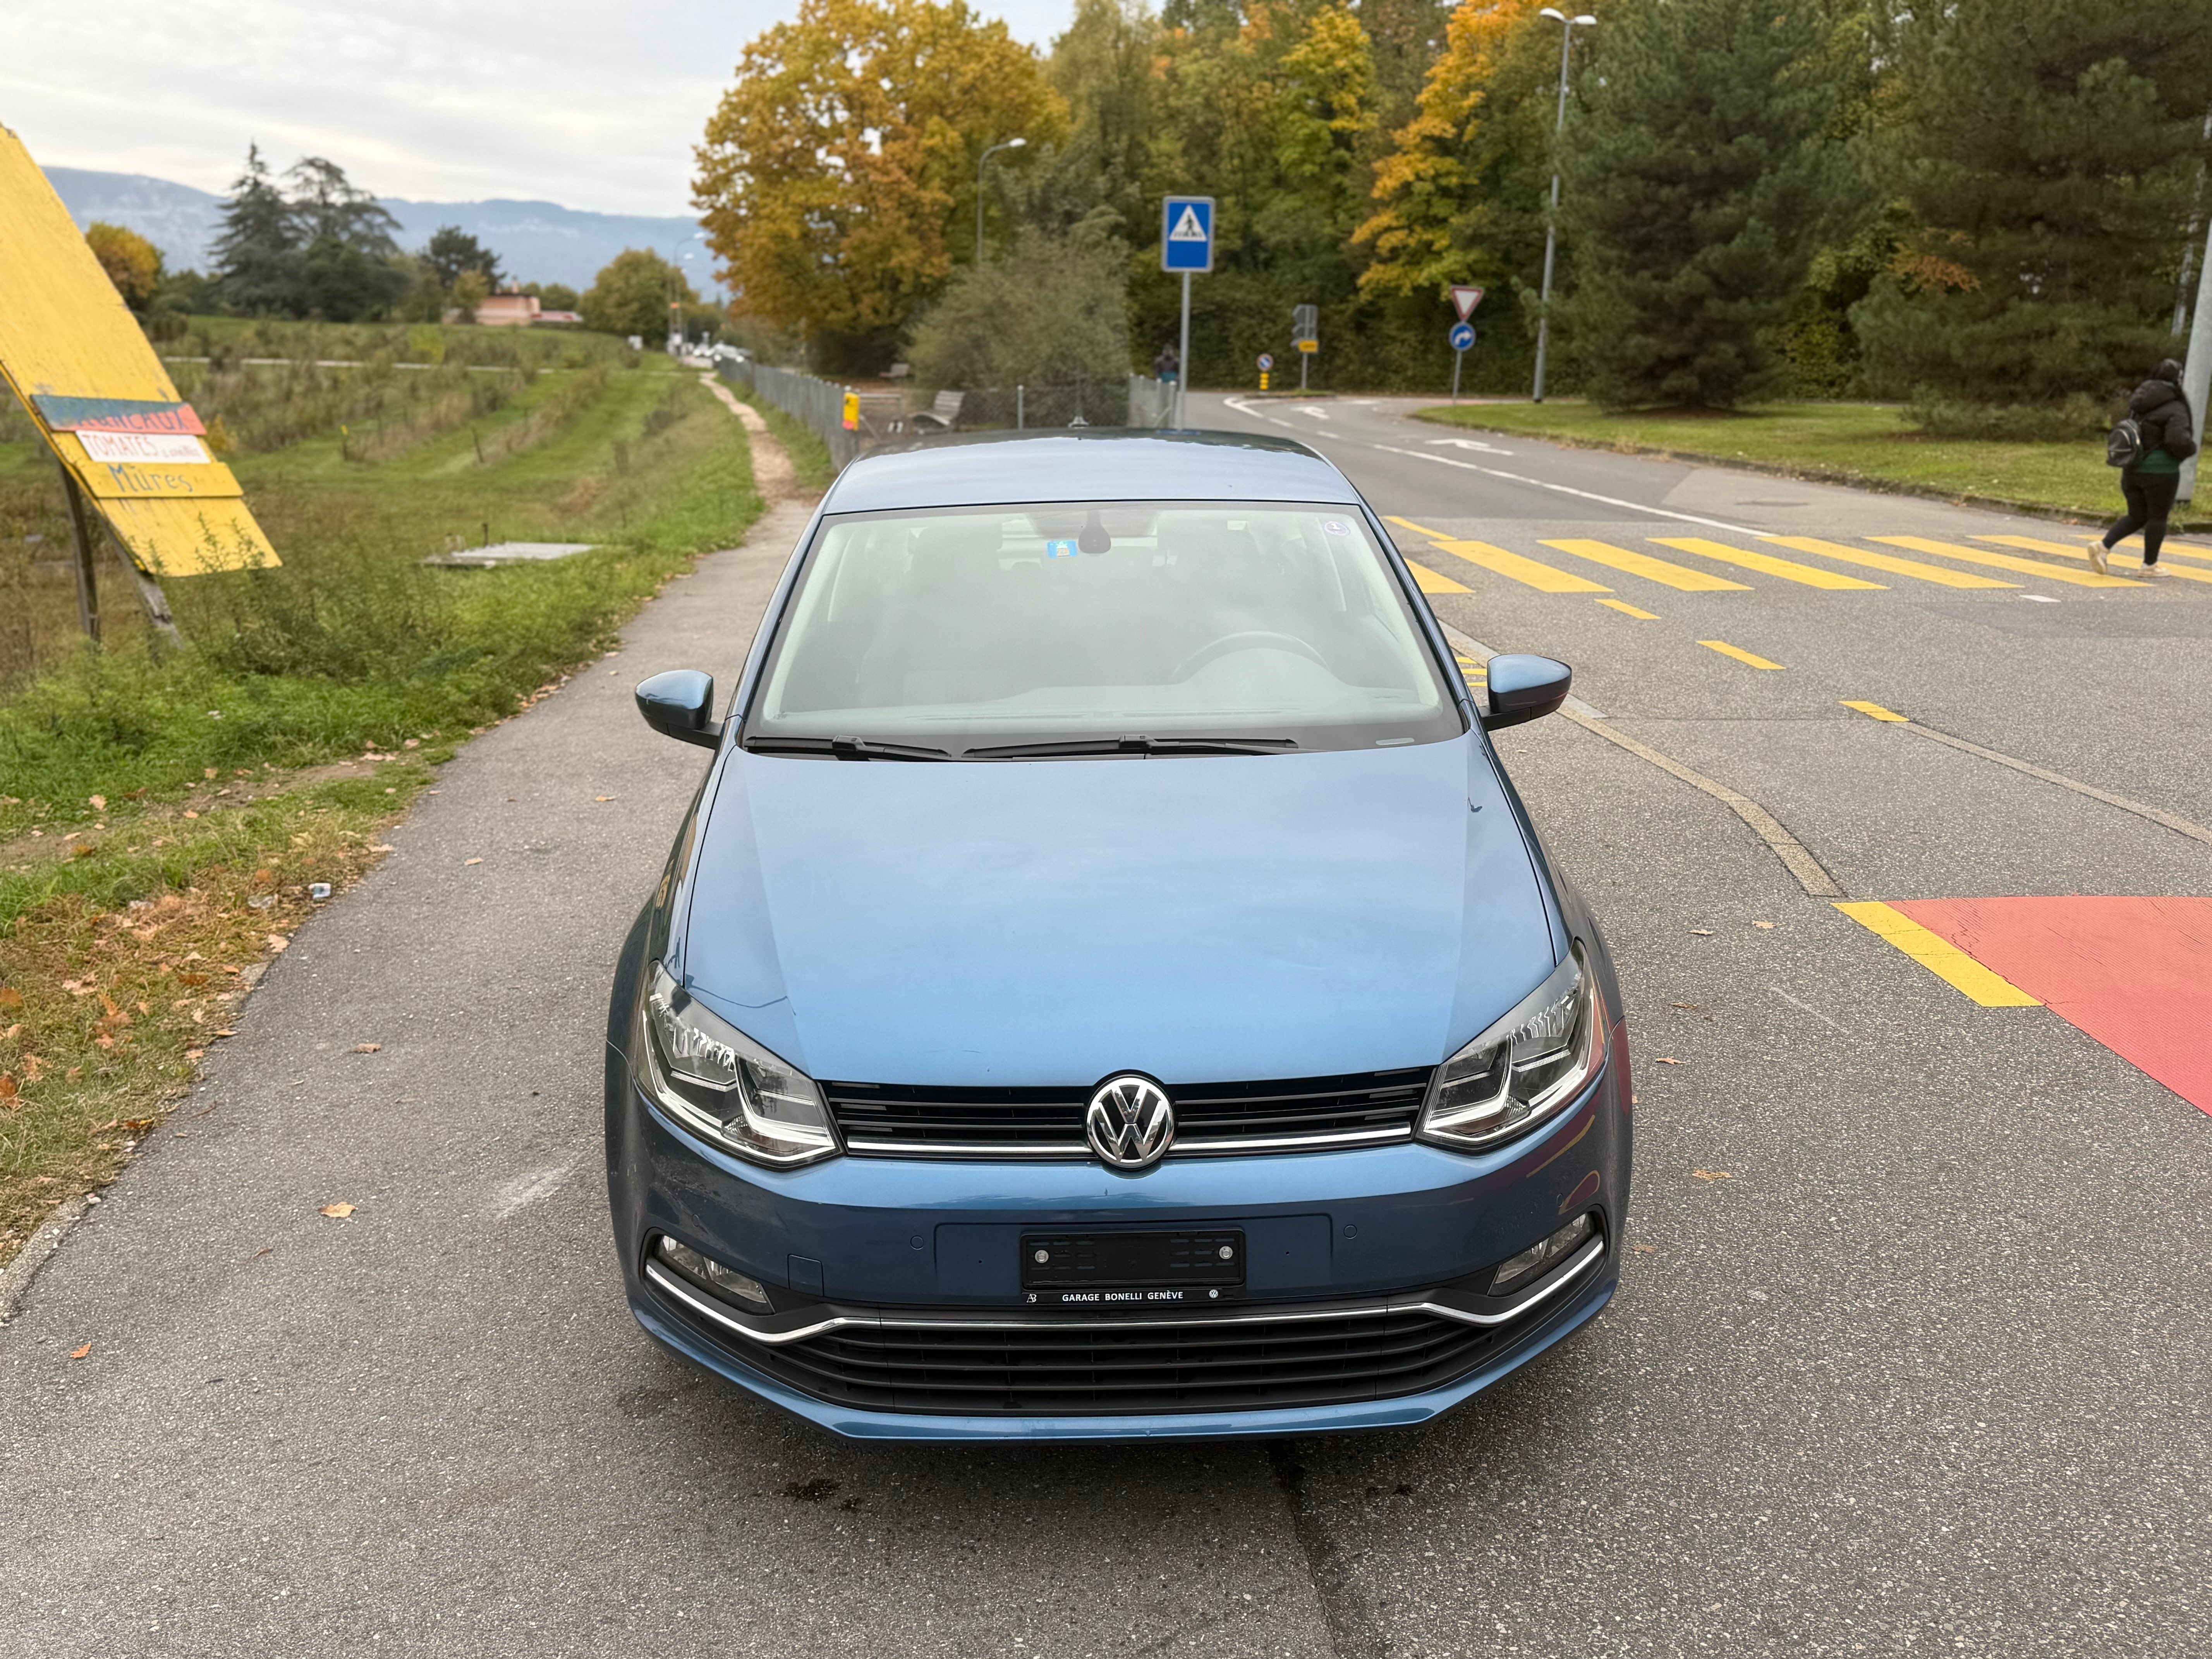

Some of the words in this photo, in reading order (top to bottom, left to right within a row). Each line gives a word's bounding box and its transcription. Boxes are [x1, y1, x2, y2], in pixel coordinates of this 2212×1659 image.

[82, 434, 158, 457] TOMATES
[1087, 1077, 1175, 1169] VW
[1062, 1293, 1100, 1302] GARAGE
[1105, 1292, 1142, 1301] BONELLI
[1147, 1290, 1183, 1300] GENÈVE
